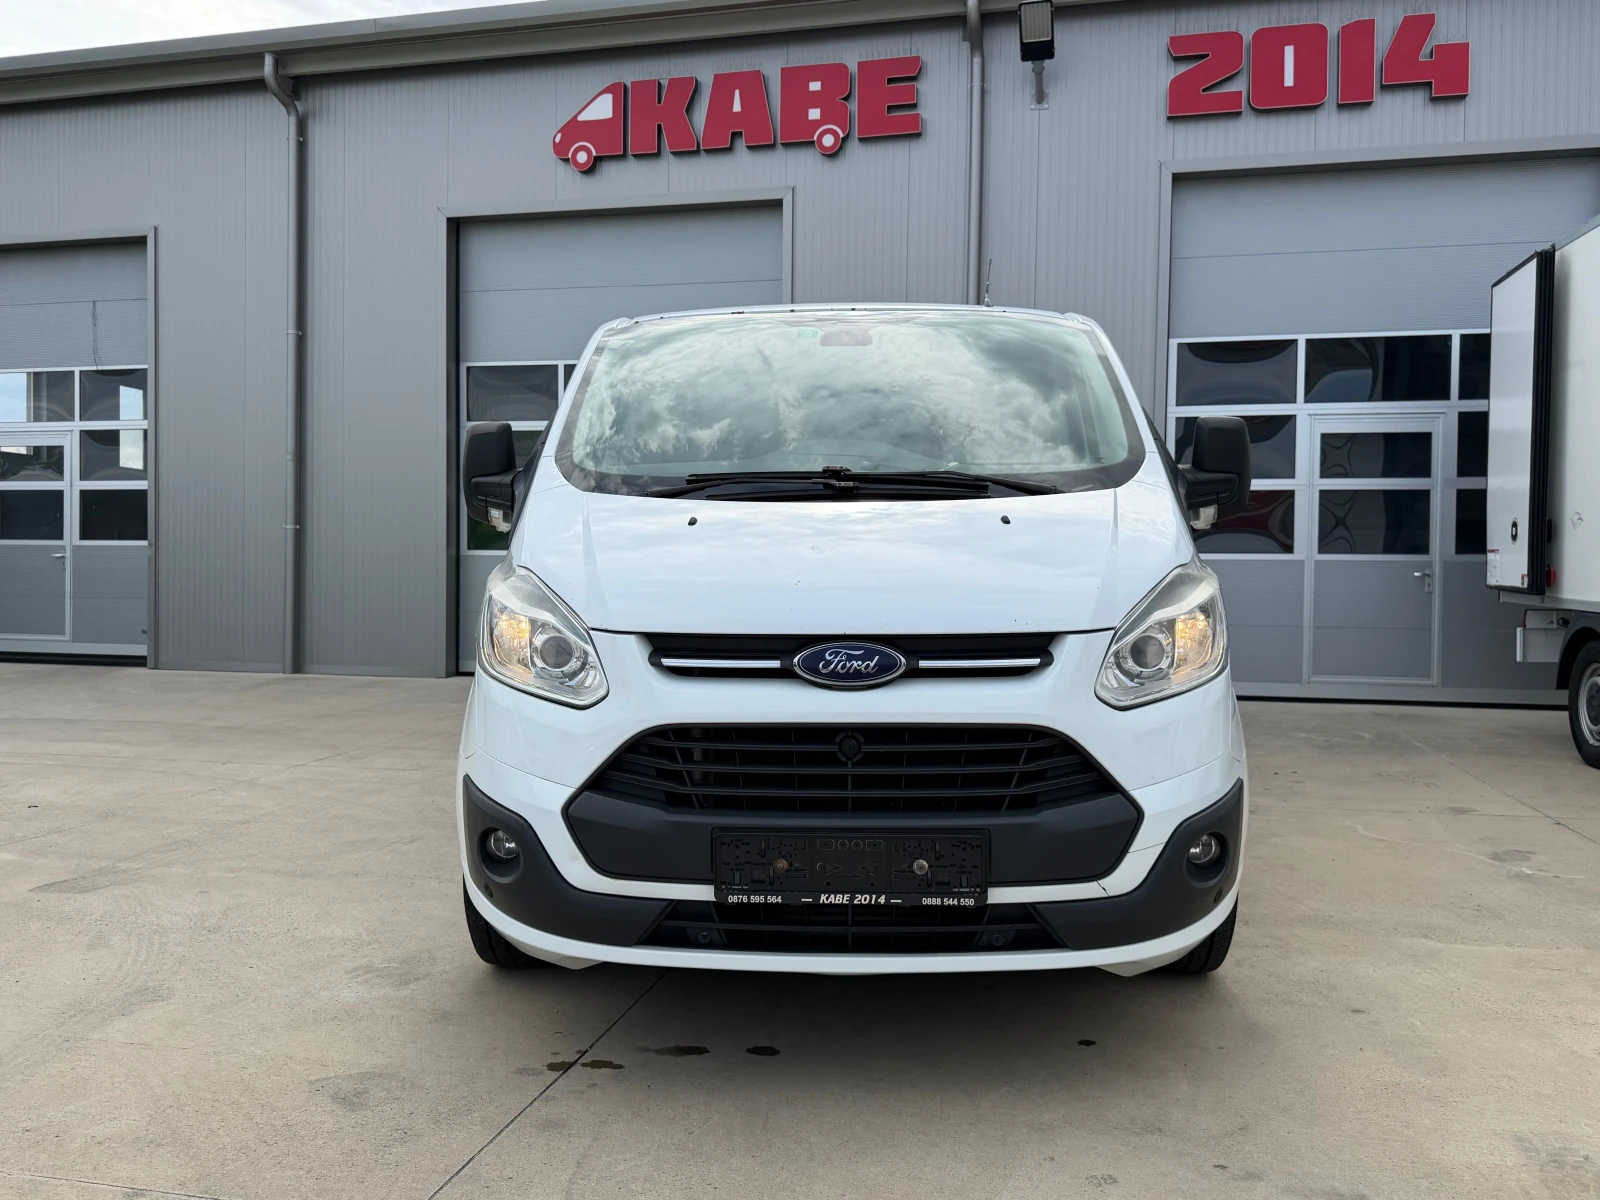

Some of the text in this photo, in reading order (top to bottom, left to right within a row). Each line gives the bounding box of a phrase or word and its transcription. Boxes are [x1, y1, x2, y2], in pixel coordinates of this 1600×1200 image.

[629, 13, 1470, 156] KABE 2014
[819, 648, 880, 674] Ford
[727, 895, 782, 904] 0876 595 564
[819, 893, 886, 905] KABE 2014
[922, 897, 975, 906] 0888 544 550
